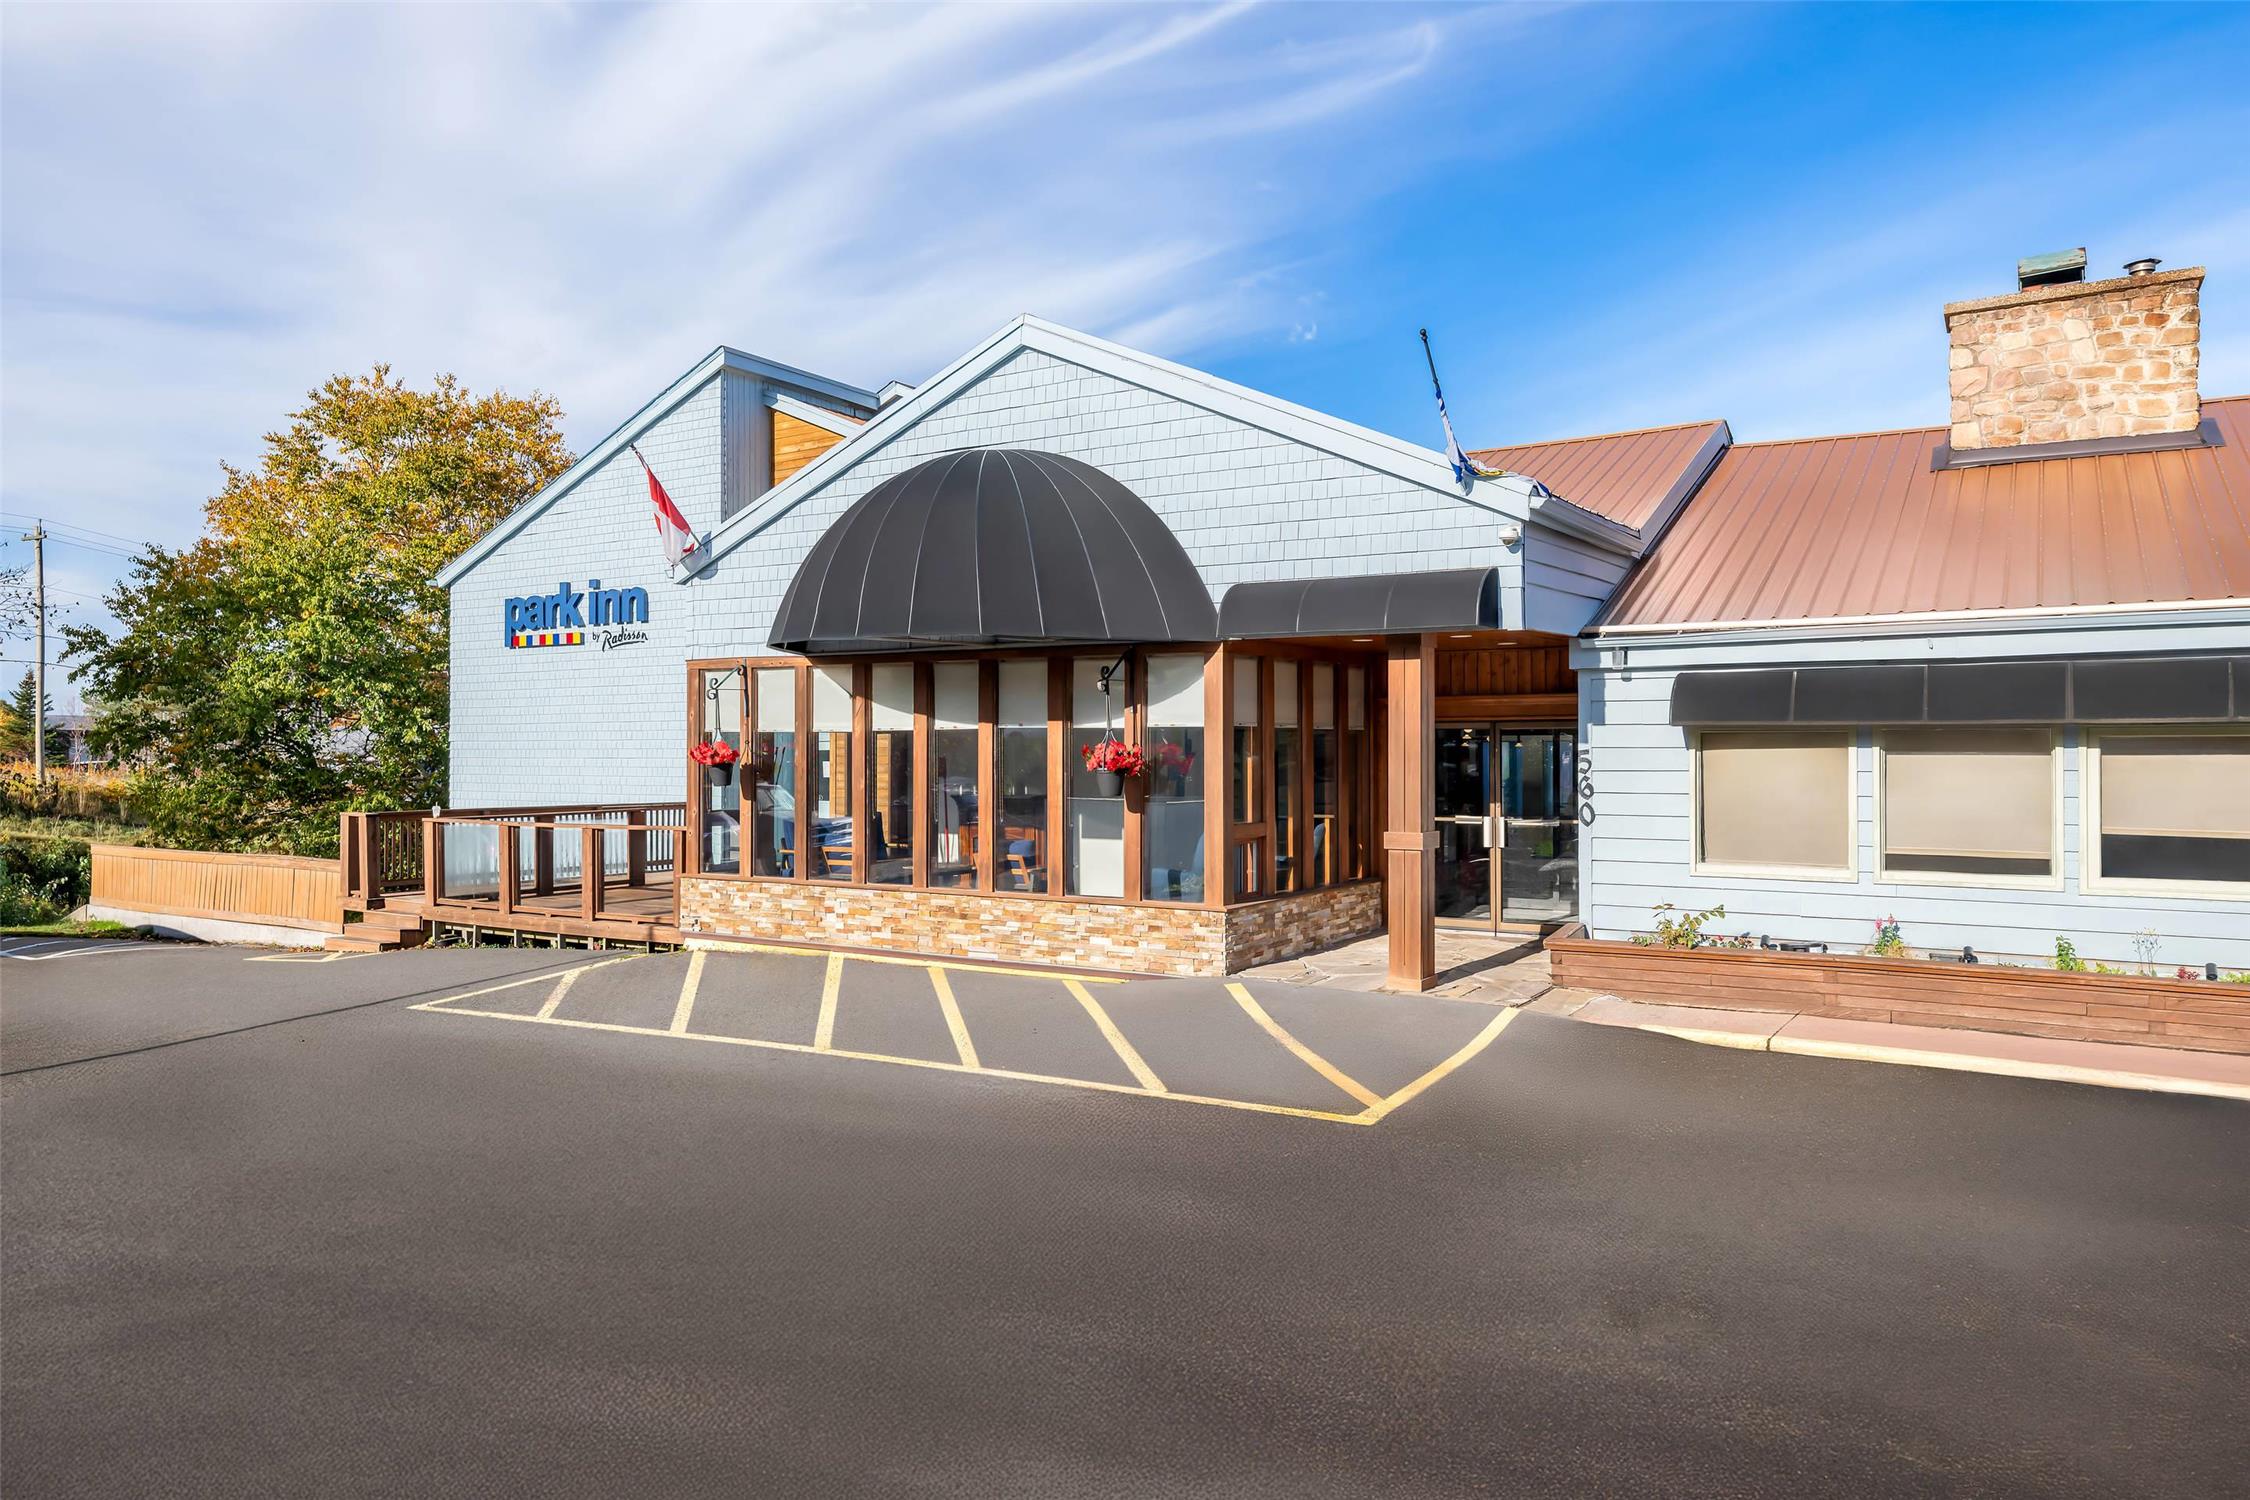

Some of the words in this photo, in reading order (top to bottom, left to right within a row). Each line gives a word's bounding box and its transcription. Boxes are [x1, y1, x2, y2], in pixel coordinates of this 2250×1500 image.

[505, 582, 586, 649] park
[588, 579, 649, 626] inn
[592, 632, 600, 643] by
[601, 626, 649, 652] Radisson
[1578, 749, 1596, 827] 560
